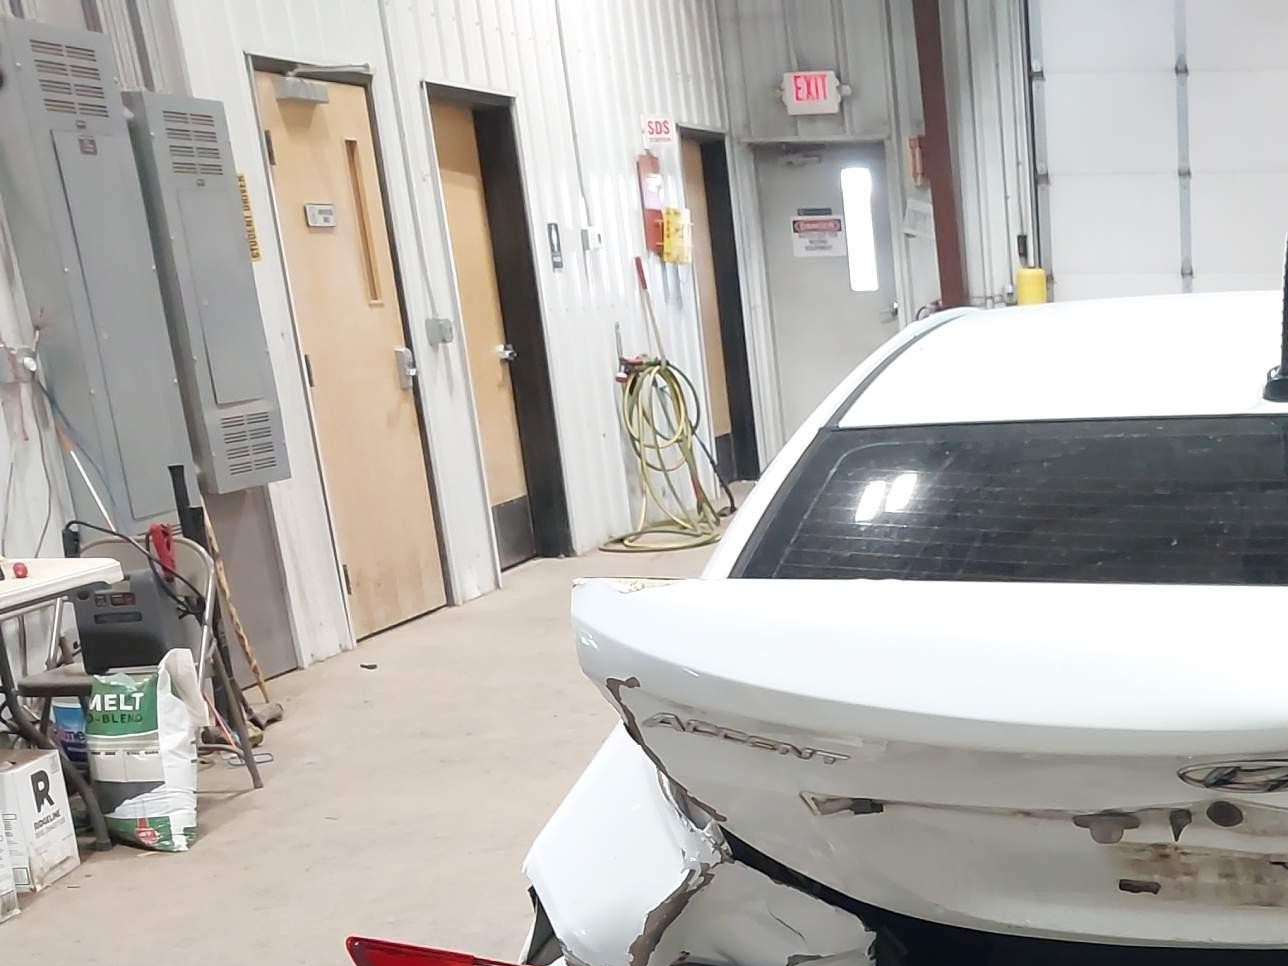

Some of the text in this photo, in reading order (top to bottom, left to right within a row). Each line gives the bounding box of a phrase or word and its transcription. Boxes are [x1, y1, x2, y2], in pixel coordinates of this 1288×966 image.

[793, 74, 828, 101] EXIT
[647, 119, 671, 136] SDS
[89, 692, 144, 711] MELT
[642, 711, 851, 766] ACCENT
